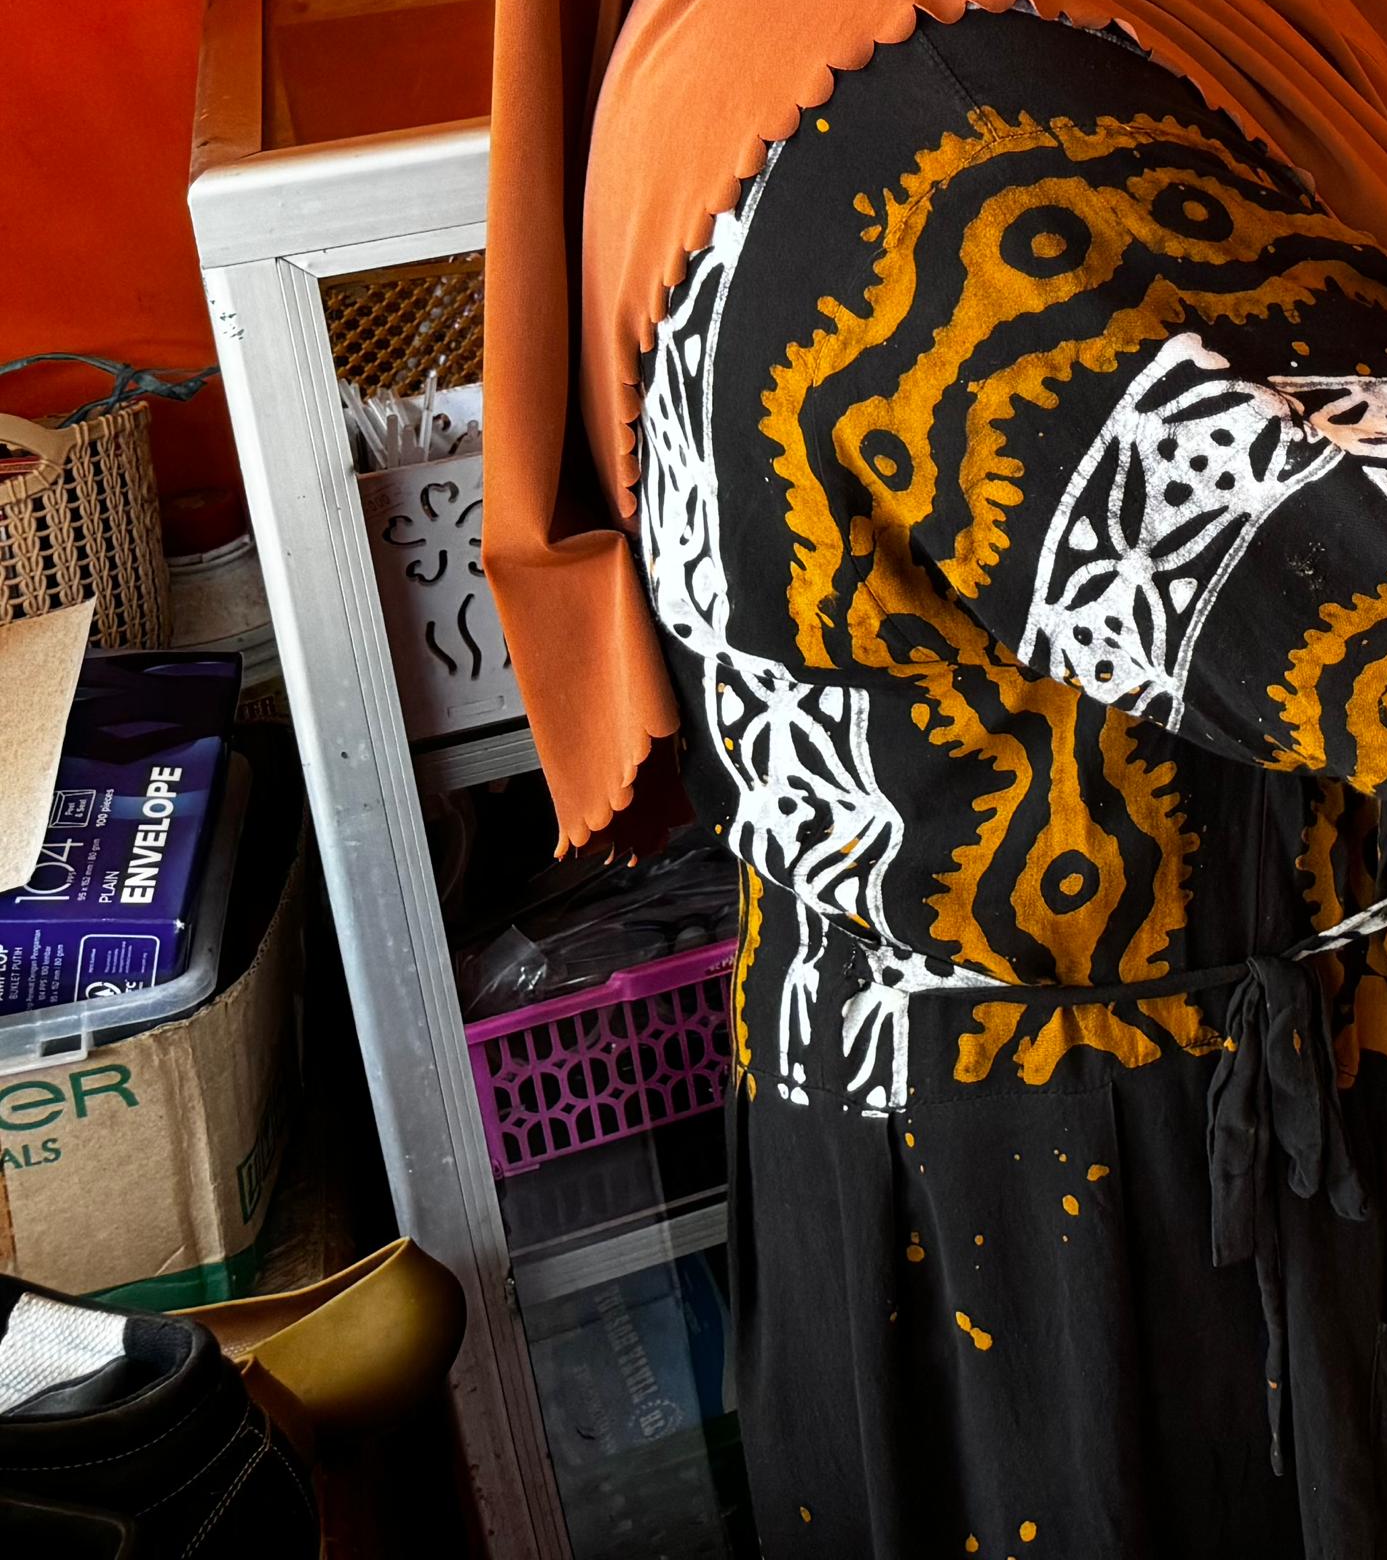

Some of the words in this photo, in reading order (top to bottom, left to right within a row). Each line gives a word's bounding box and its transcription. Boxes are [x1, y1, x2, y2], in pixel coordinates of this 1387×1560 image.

[98, 789, 115, 812] pieces
[95, 813, 109, 827] 100
[119, 767, 184, 904] ENVELOPE
[15, 838, 84, 904] 104
[98, 871, 121, 904] PLAIN
[10, 947, 23, 970] PUTIH
